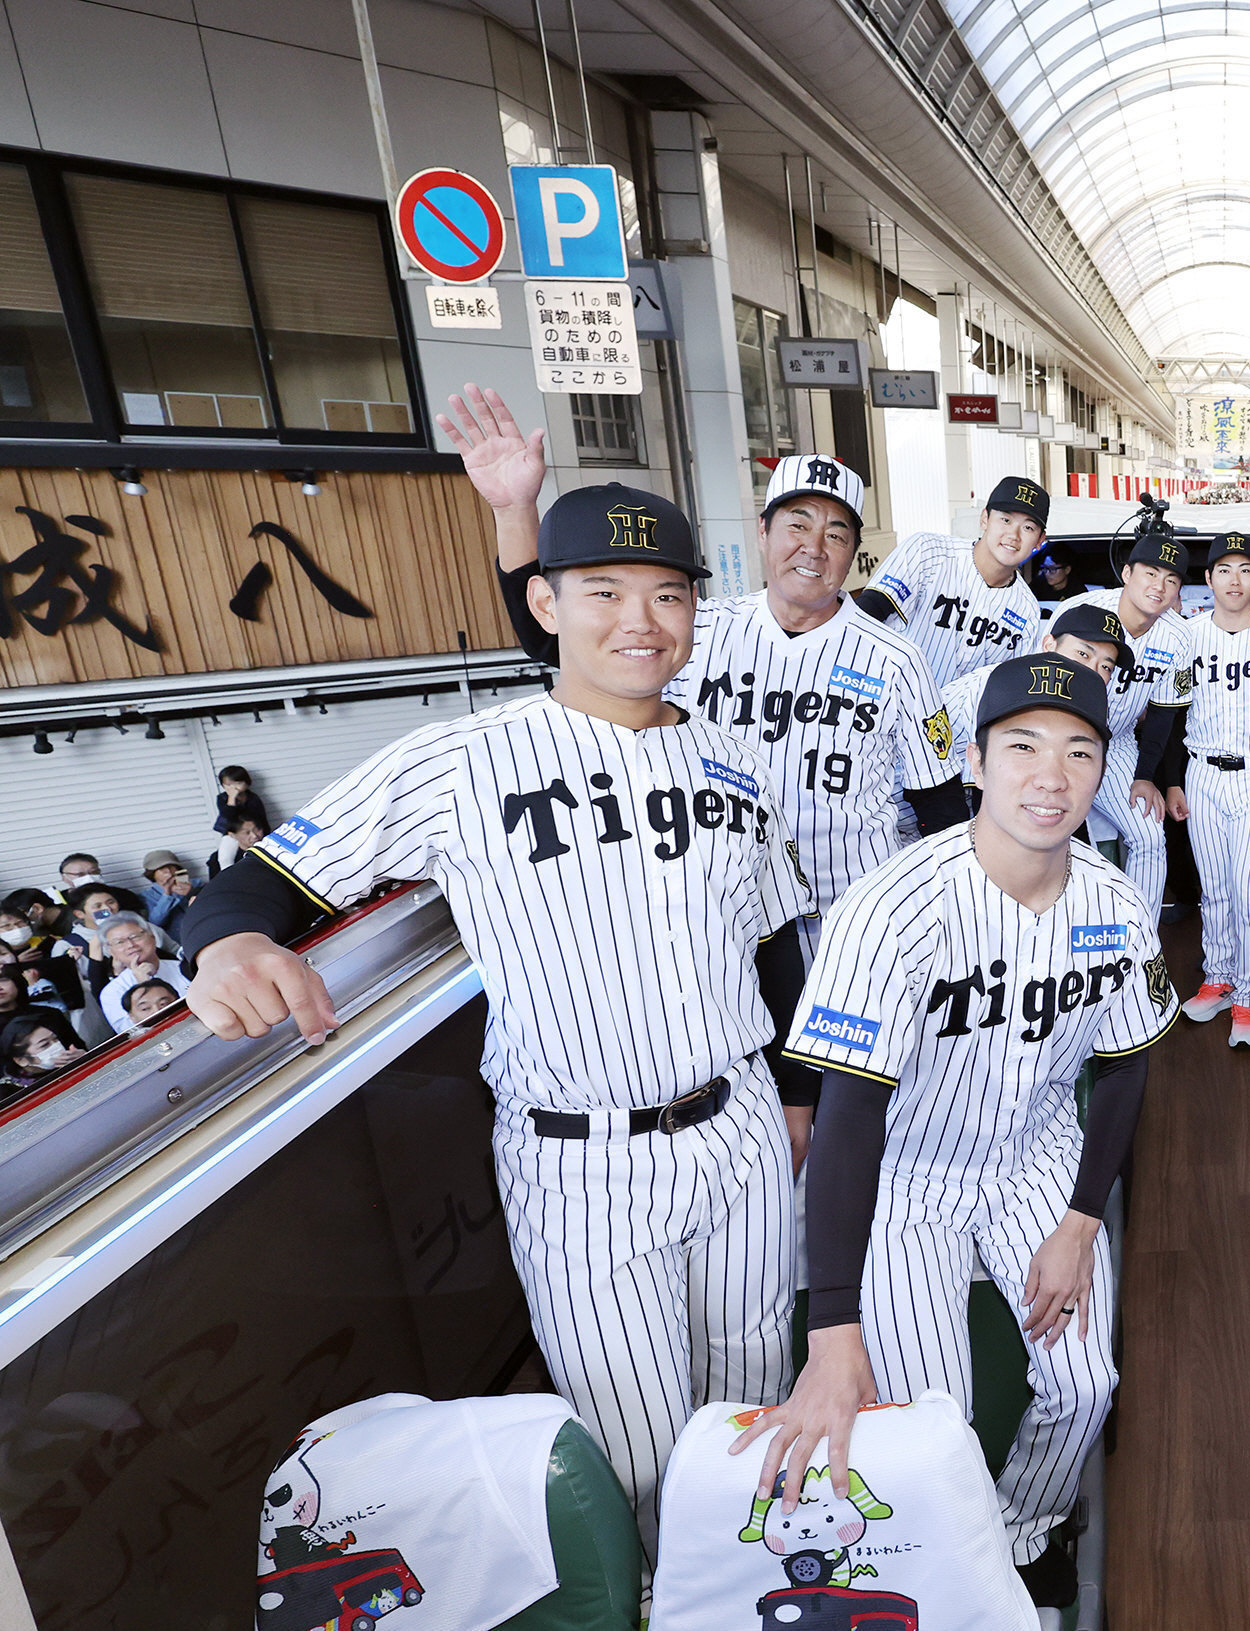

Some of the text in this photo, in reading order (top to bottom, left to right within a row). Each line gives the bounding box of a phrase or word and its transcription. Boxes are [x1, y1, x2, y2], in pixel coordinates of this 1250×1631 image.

[434, 299, 496, 318] 自転車を除く
[539, 308, 623, 326] 貨物の積降し
[545, 328, 623, 345] のための
[543, 347, 630, 364] 自動車に限る
[789, 360, 850, 373] 松浦屋
[551, 371, 627, 386] ここから
[882, 577, 910, 601] Joshin
[933, 593, 1022, 651] Tigers
[1003, 609, 1026, 627] Joshin
[1145, 649, 1172, 663] Joshin
[831, 669, 884, 696] Joshin
[698, 673, 881, 744] Tigers
[704, 760, 759, 795] Joshin
[804, 749, 853, 794] 19
[503, 773, 769, 862] Tigers
[1072, 928, 1126, 948] Joshin
[928, 957, 1132, 1043] Tigers
[808, 1011, 875, 1049] Joshin
